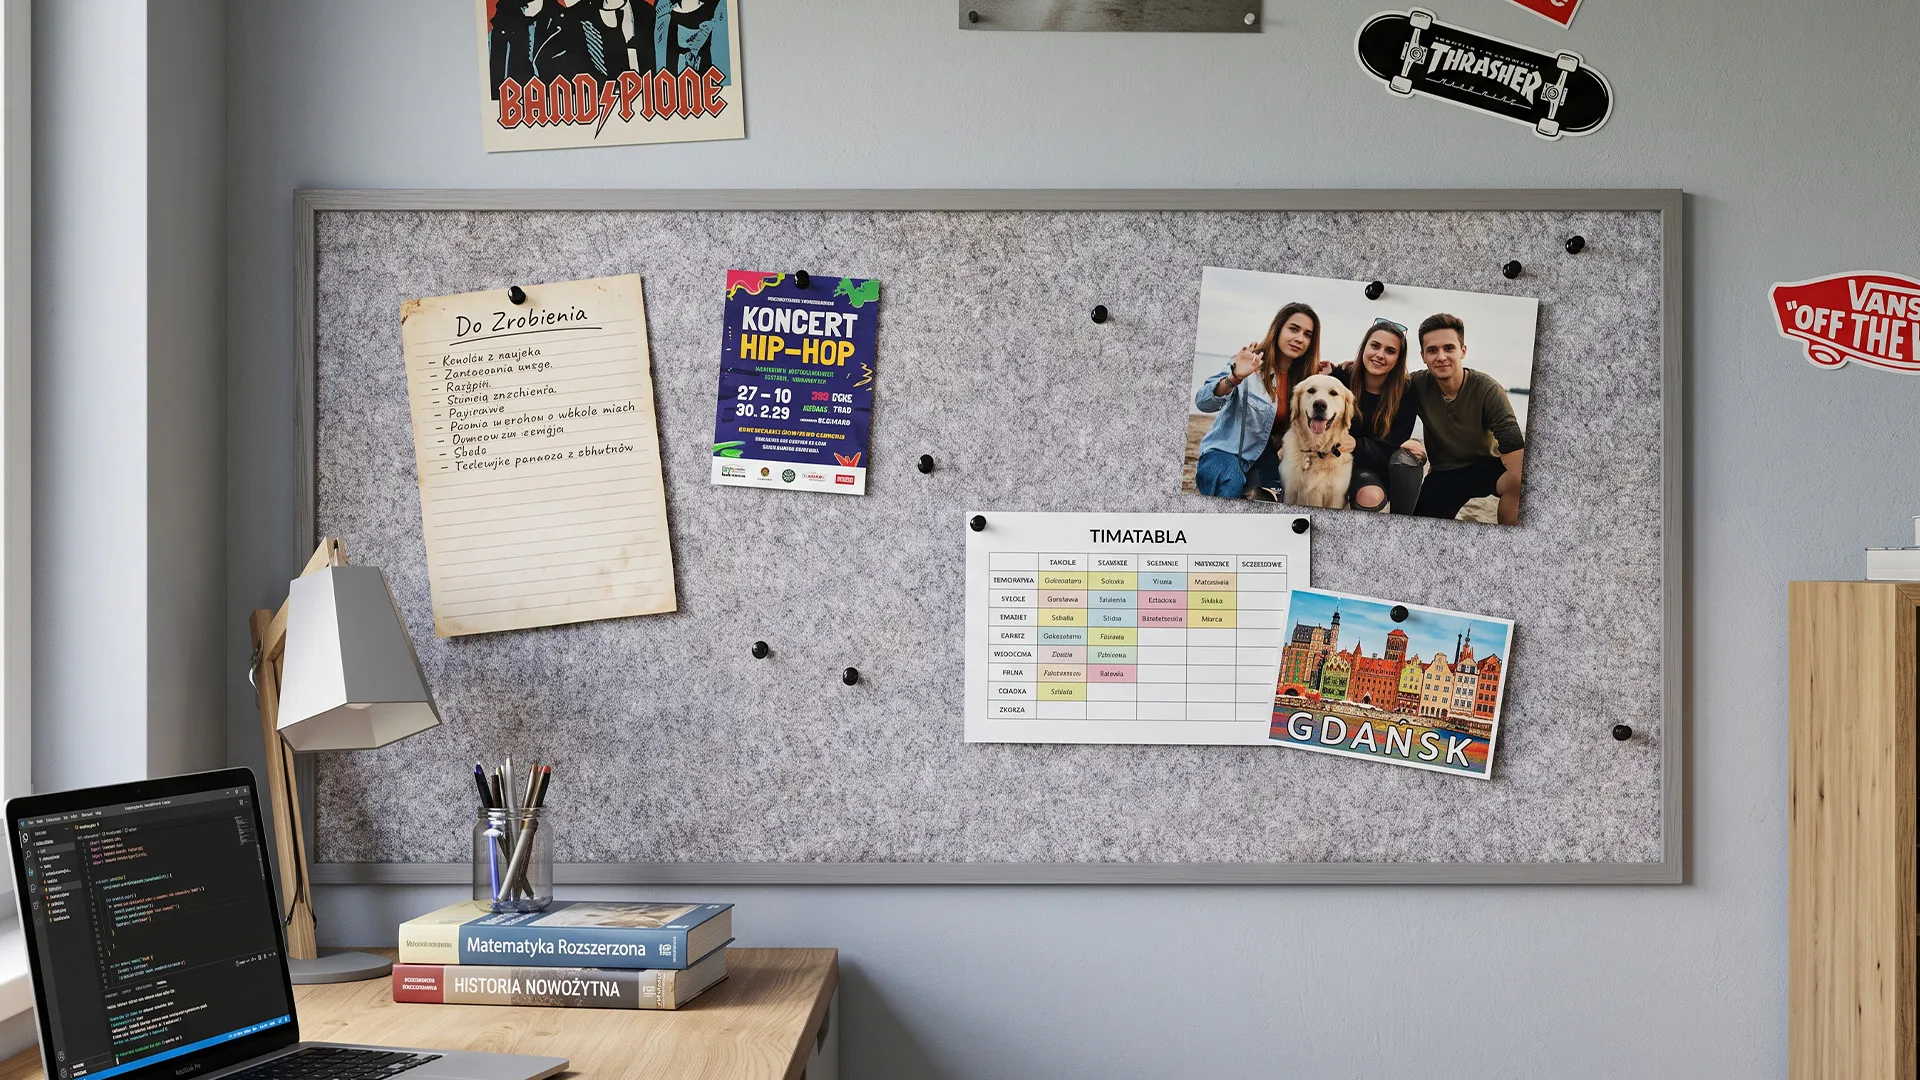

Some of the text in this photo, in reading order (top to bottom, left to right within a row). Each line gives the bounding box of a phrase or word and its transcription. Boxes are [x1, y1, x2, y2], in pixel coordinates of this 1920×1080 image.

[1427, 41, 1542, 105] THRASHER
[498, 66, 728, 129] BAND PIONE
[456, 306, 588, 337] Do Zrobienia
[742, 305, 858, 338] KONCERT
[1850, 313, 1907, 360] THE
[740, 334, 855, 367] HIP-HOP
[602, 401, 635, 414] miach
[737, 385, 758, 401] 27
[774, 387, 792, 404] 10
[760, 405, 790, 420] 2.29
[1090, 529, 1187, 544] TIMATABLA
[467, 937, 554, 958] Matematyka
[558, 939, 646, 957] Rozszerzona
[454, 977, 521, 994] HISTORIA
[526, 977, 620, 997] NOWOŻYTNA
